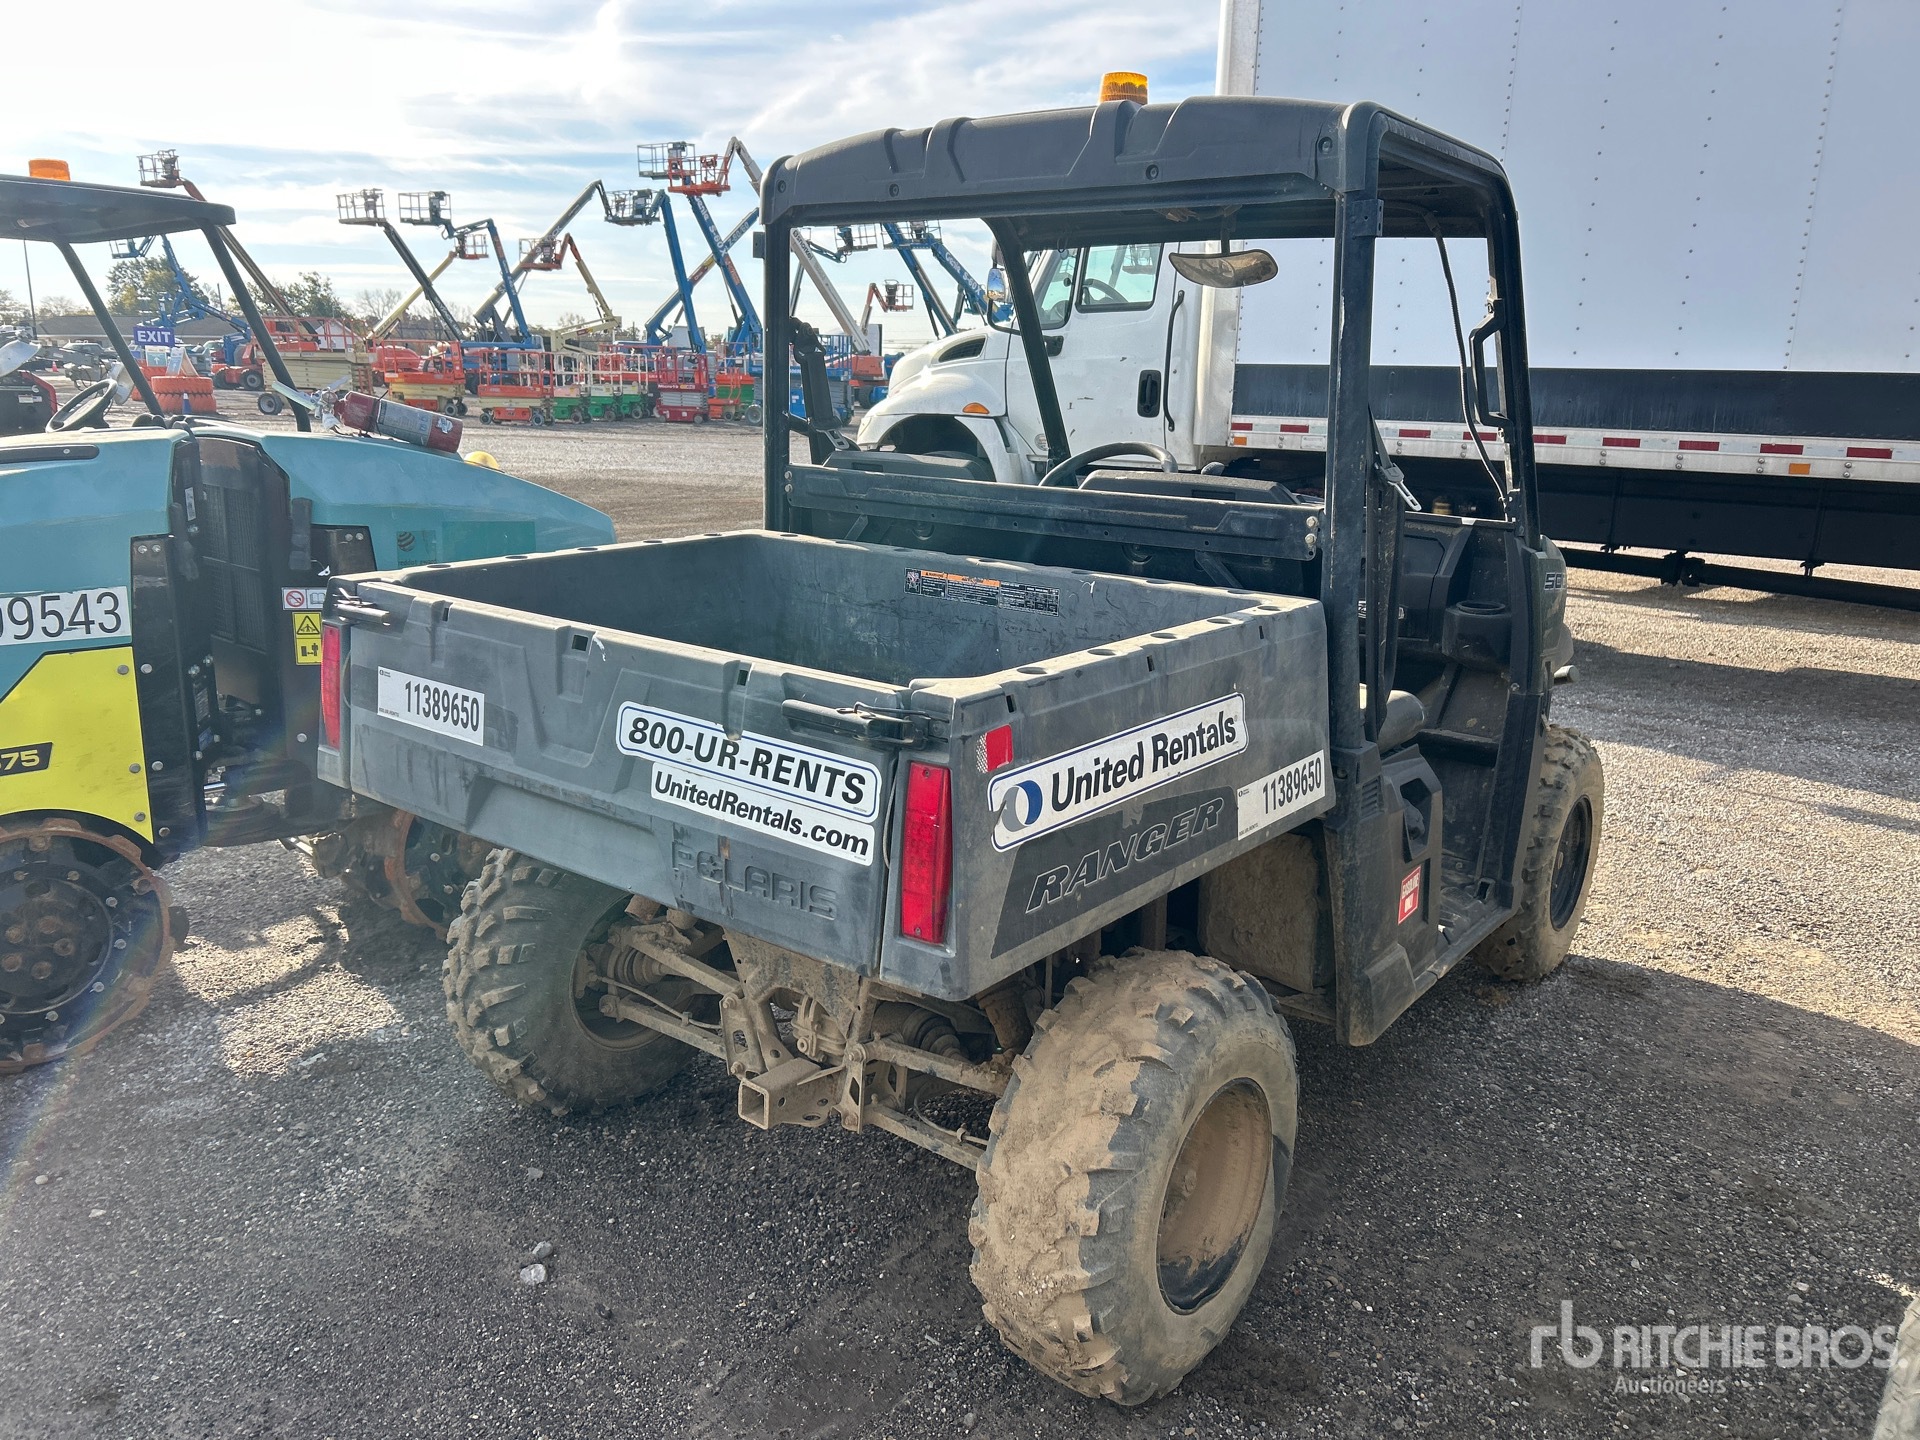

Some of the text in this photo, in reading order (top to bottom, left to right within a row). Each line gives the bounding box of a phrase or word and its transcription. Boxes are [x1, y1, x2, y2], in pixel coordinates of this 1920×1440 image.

[136, 330, 171, 343] EXIT
[0, 591, 122, 641] 9543
[405, 681, 480, 732] 11389650
[0, 749, 40, 771] 75
[628, 717, 867, 805] 800-UR-RENTS
[1051, 711, 1237, 812] United Rentals
[1262, 757, 1322, 815] 11389650
[655, 770, 869, 856] UnitedRentals.com
[672, 841, 838, 922] POLARIS
[1025, 797, 1225, 914] RANGER
